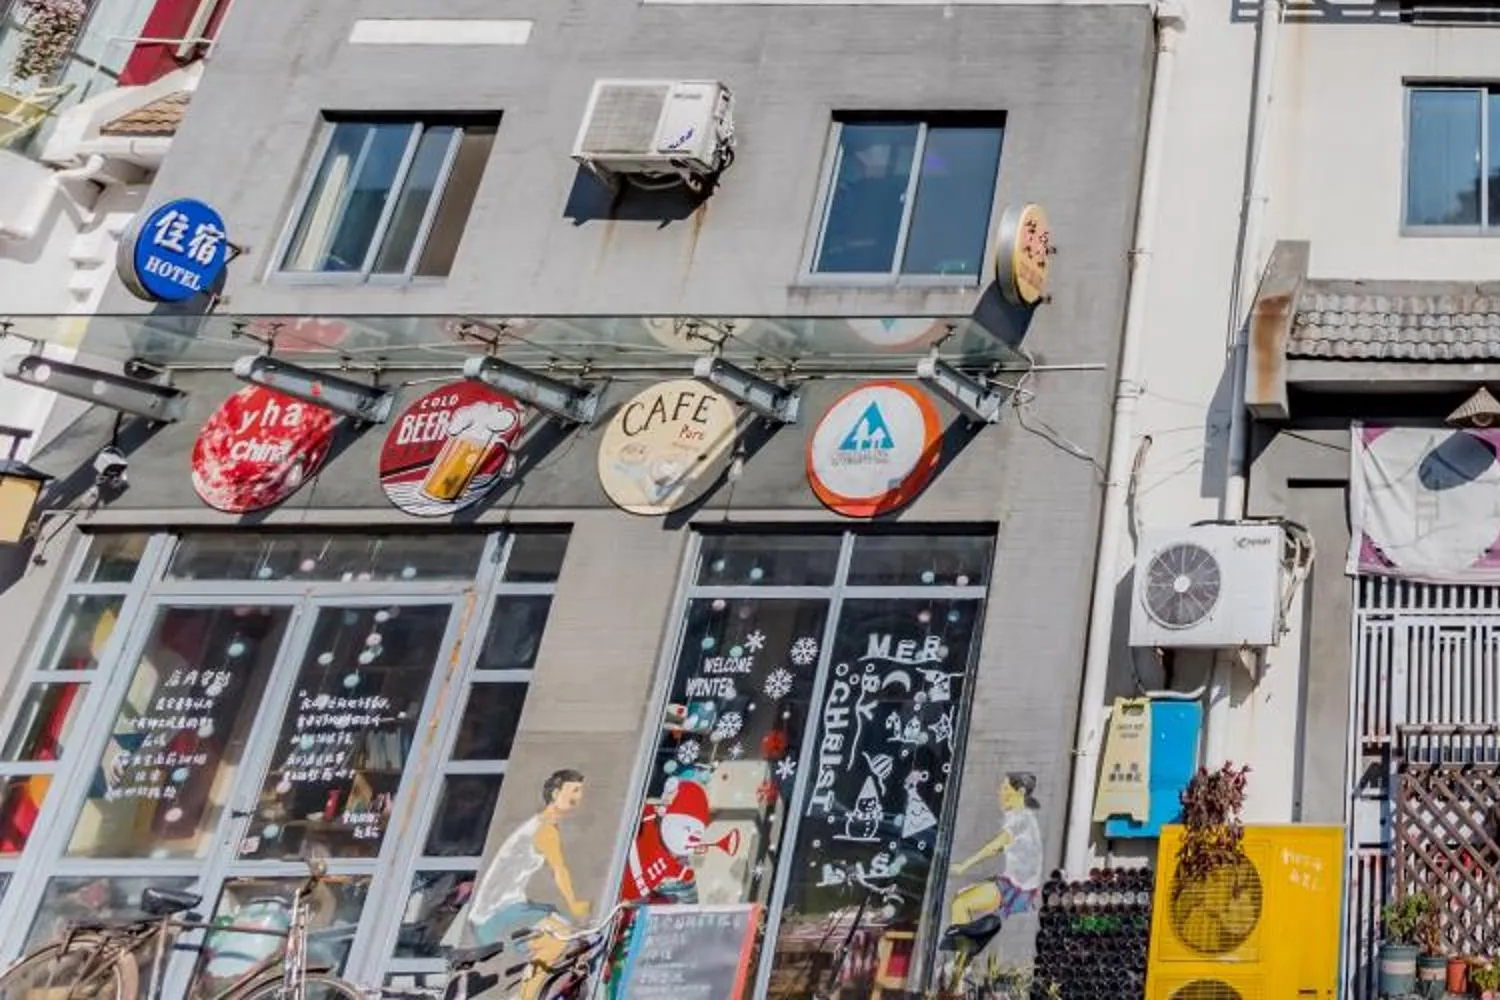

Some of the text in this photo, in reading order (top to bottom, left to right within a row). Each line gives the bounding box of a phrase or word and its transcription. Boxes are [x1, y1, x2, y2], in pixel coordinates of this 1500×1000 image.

[153, 209, 225, 266] 住宿
[143, 255, 202, 292] HOTEL
[235, 397, 303, 435] yha
[420, 394, 459, 409] COLD
[622, 391, 718, 437] CAFE
[397, 409, 455, 445] BEER
[703, 655, 754, 674] WELCOME
[685, 676, 735, 698] WINTER
